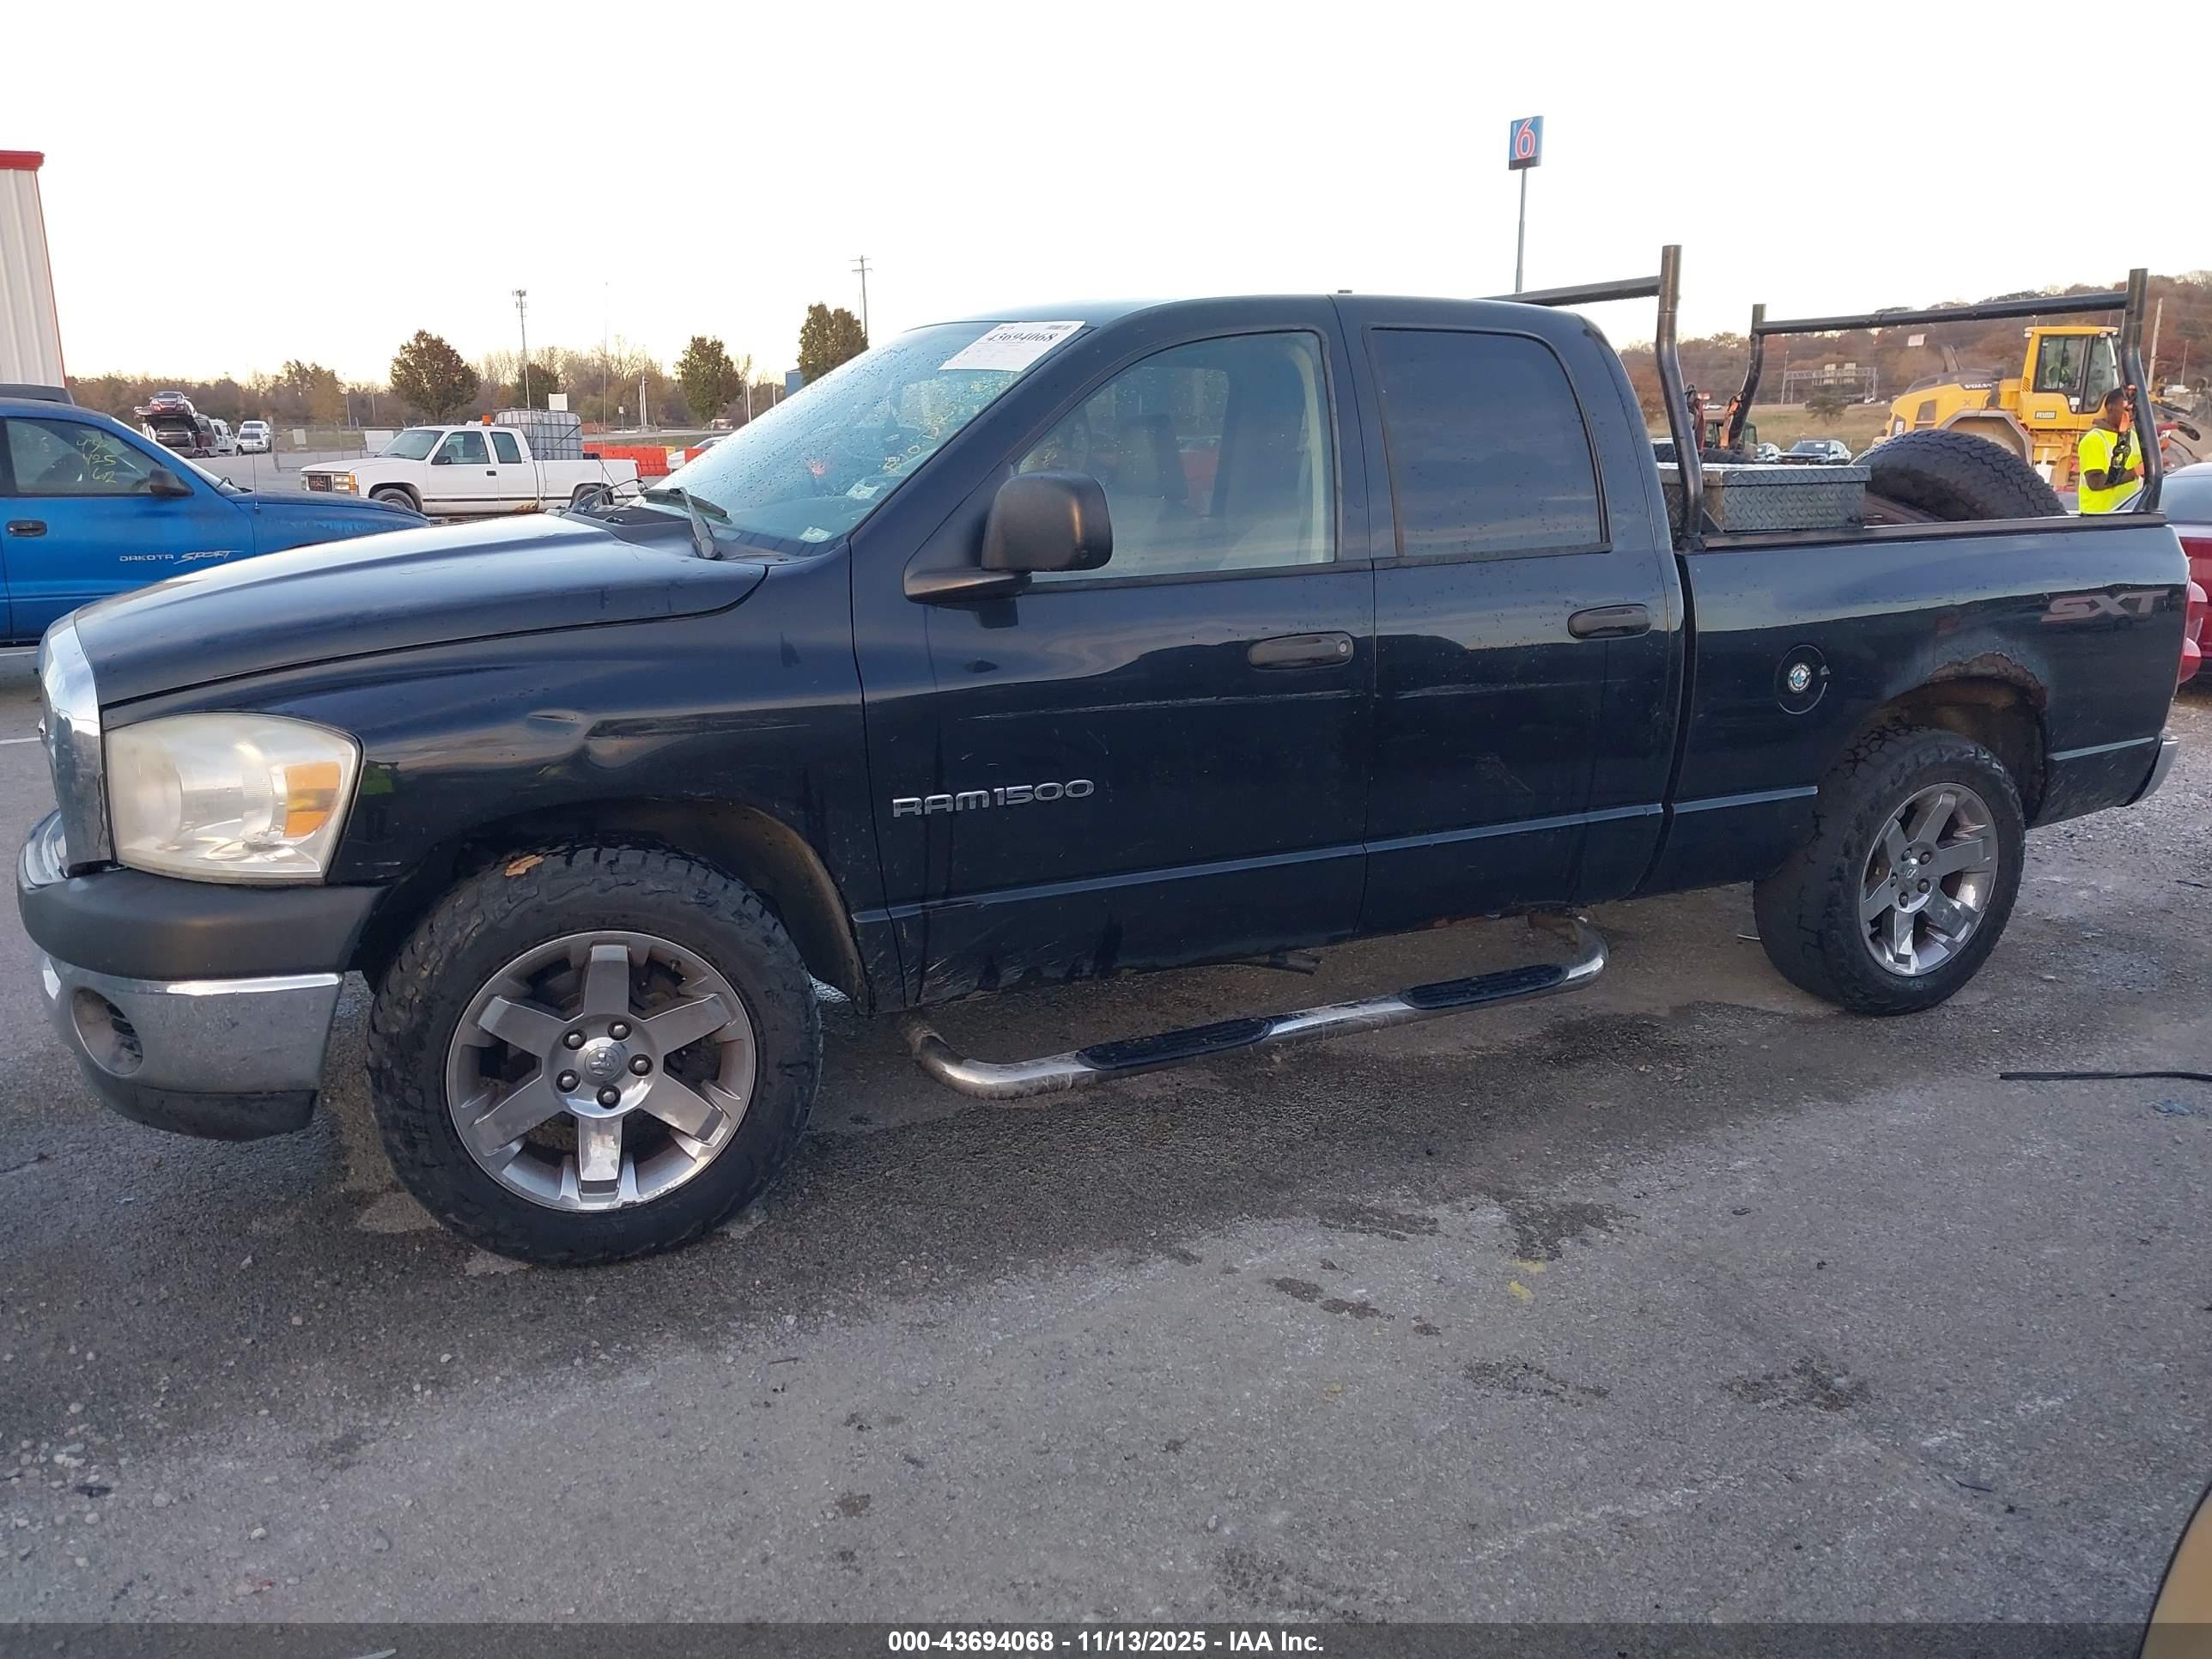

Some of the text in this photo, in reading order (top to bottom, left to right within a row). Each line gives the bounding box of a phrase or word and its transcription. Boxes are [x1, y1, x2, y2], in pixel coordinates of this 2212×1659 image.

[1516, 118, 1535, 159] 6
[987, 332, 1059, 343] 43694068
[173, 550, 241, 565] SPORT
[2041, 589, 2170, 623] SXT
